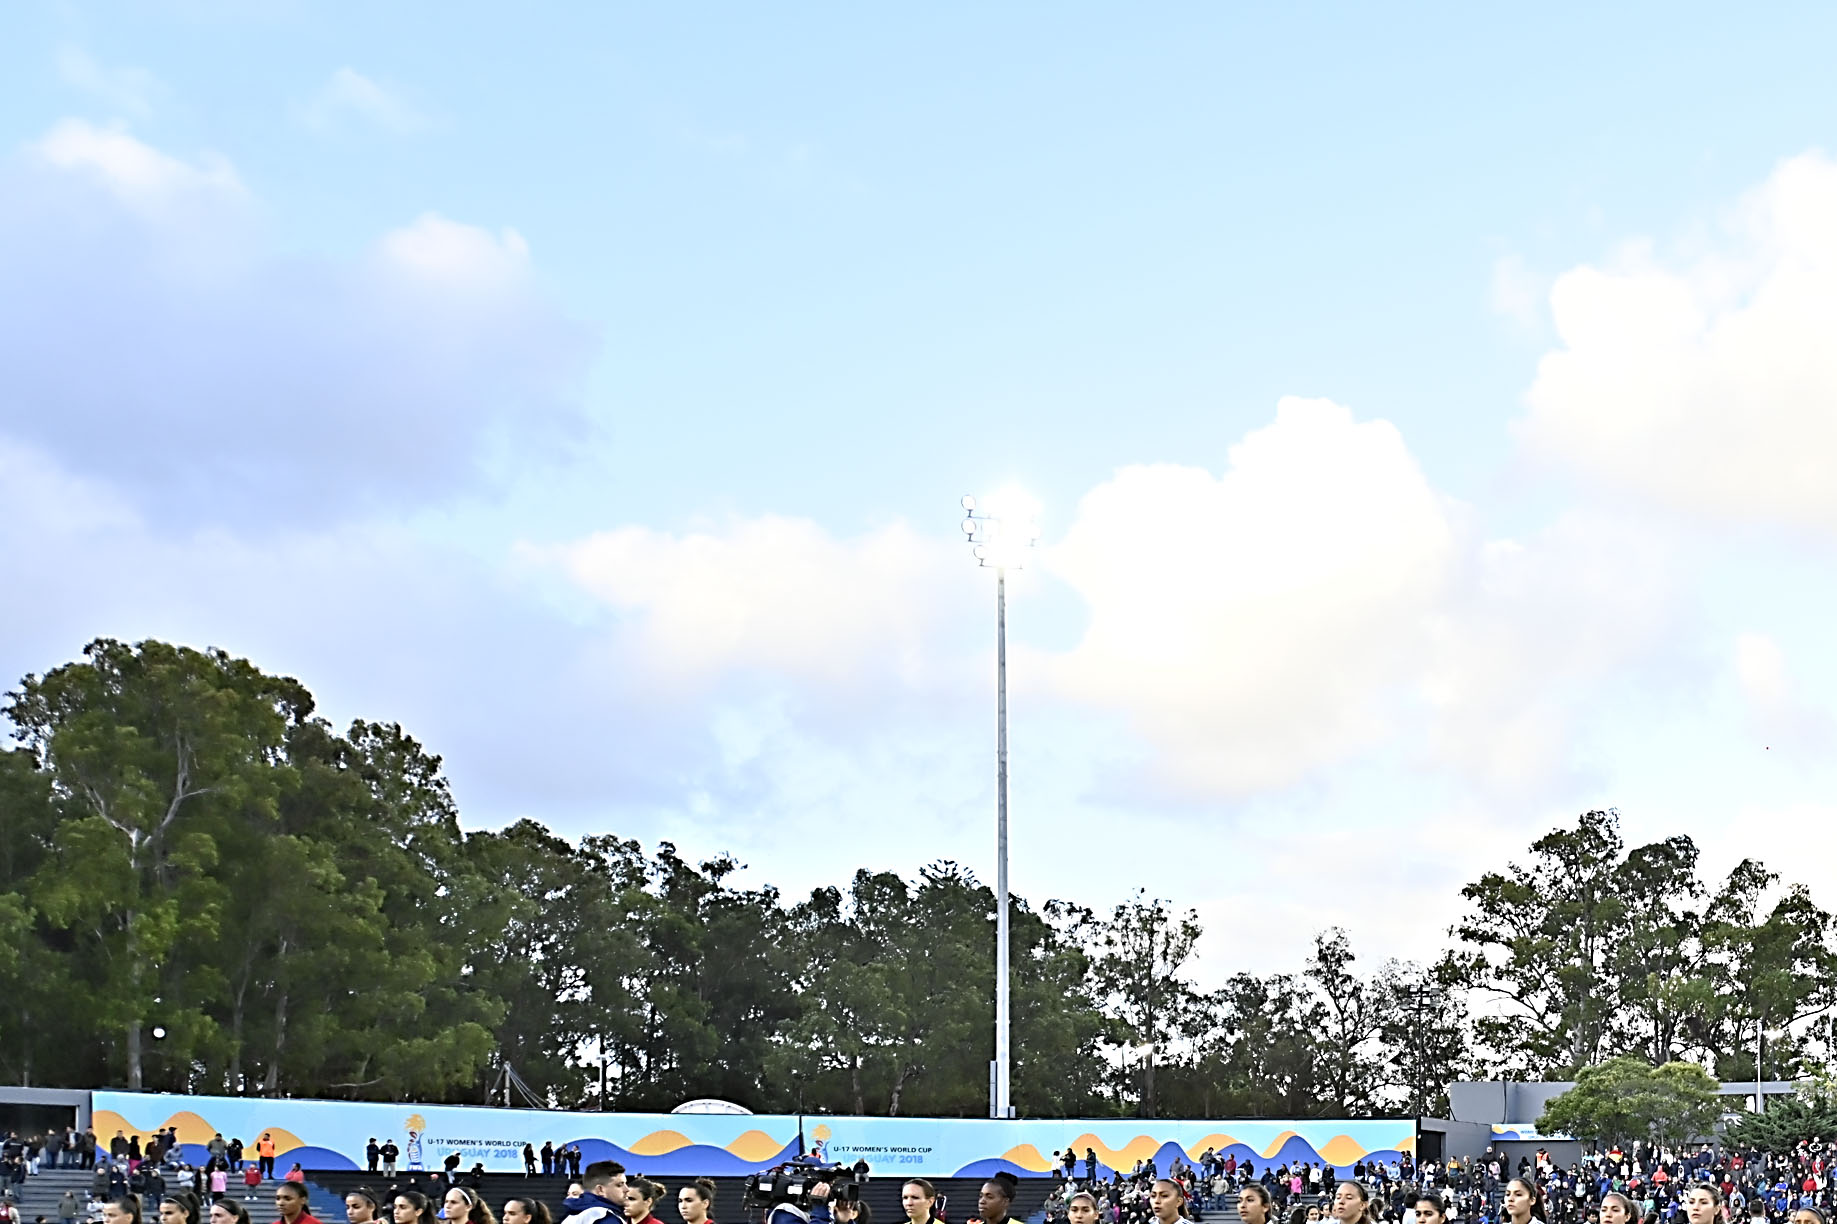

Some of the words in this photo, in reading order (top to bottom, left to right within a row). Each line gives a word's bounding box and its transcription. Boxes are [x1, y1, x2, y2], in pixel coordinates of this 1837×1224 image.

[446, 1138, 483, 1146] WOMEN'S
[485, 1139, 511, 1147] WORLD
[494, 1149, 518, 1159] 2018
[900, 1155, 923, 1164] 2018
